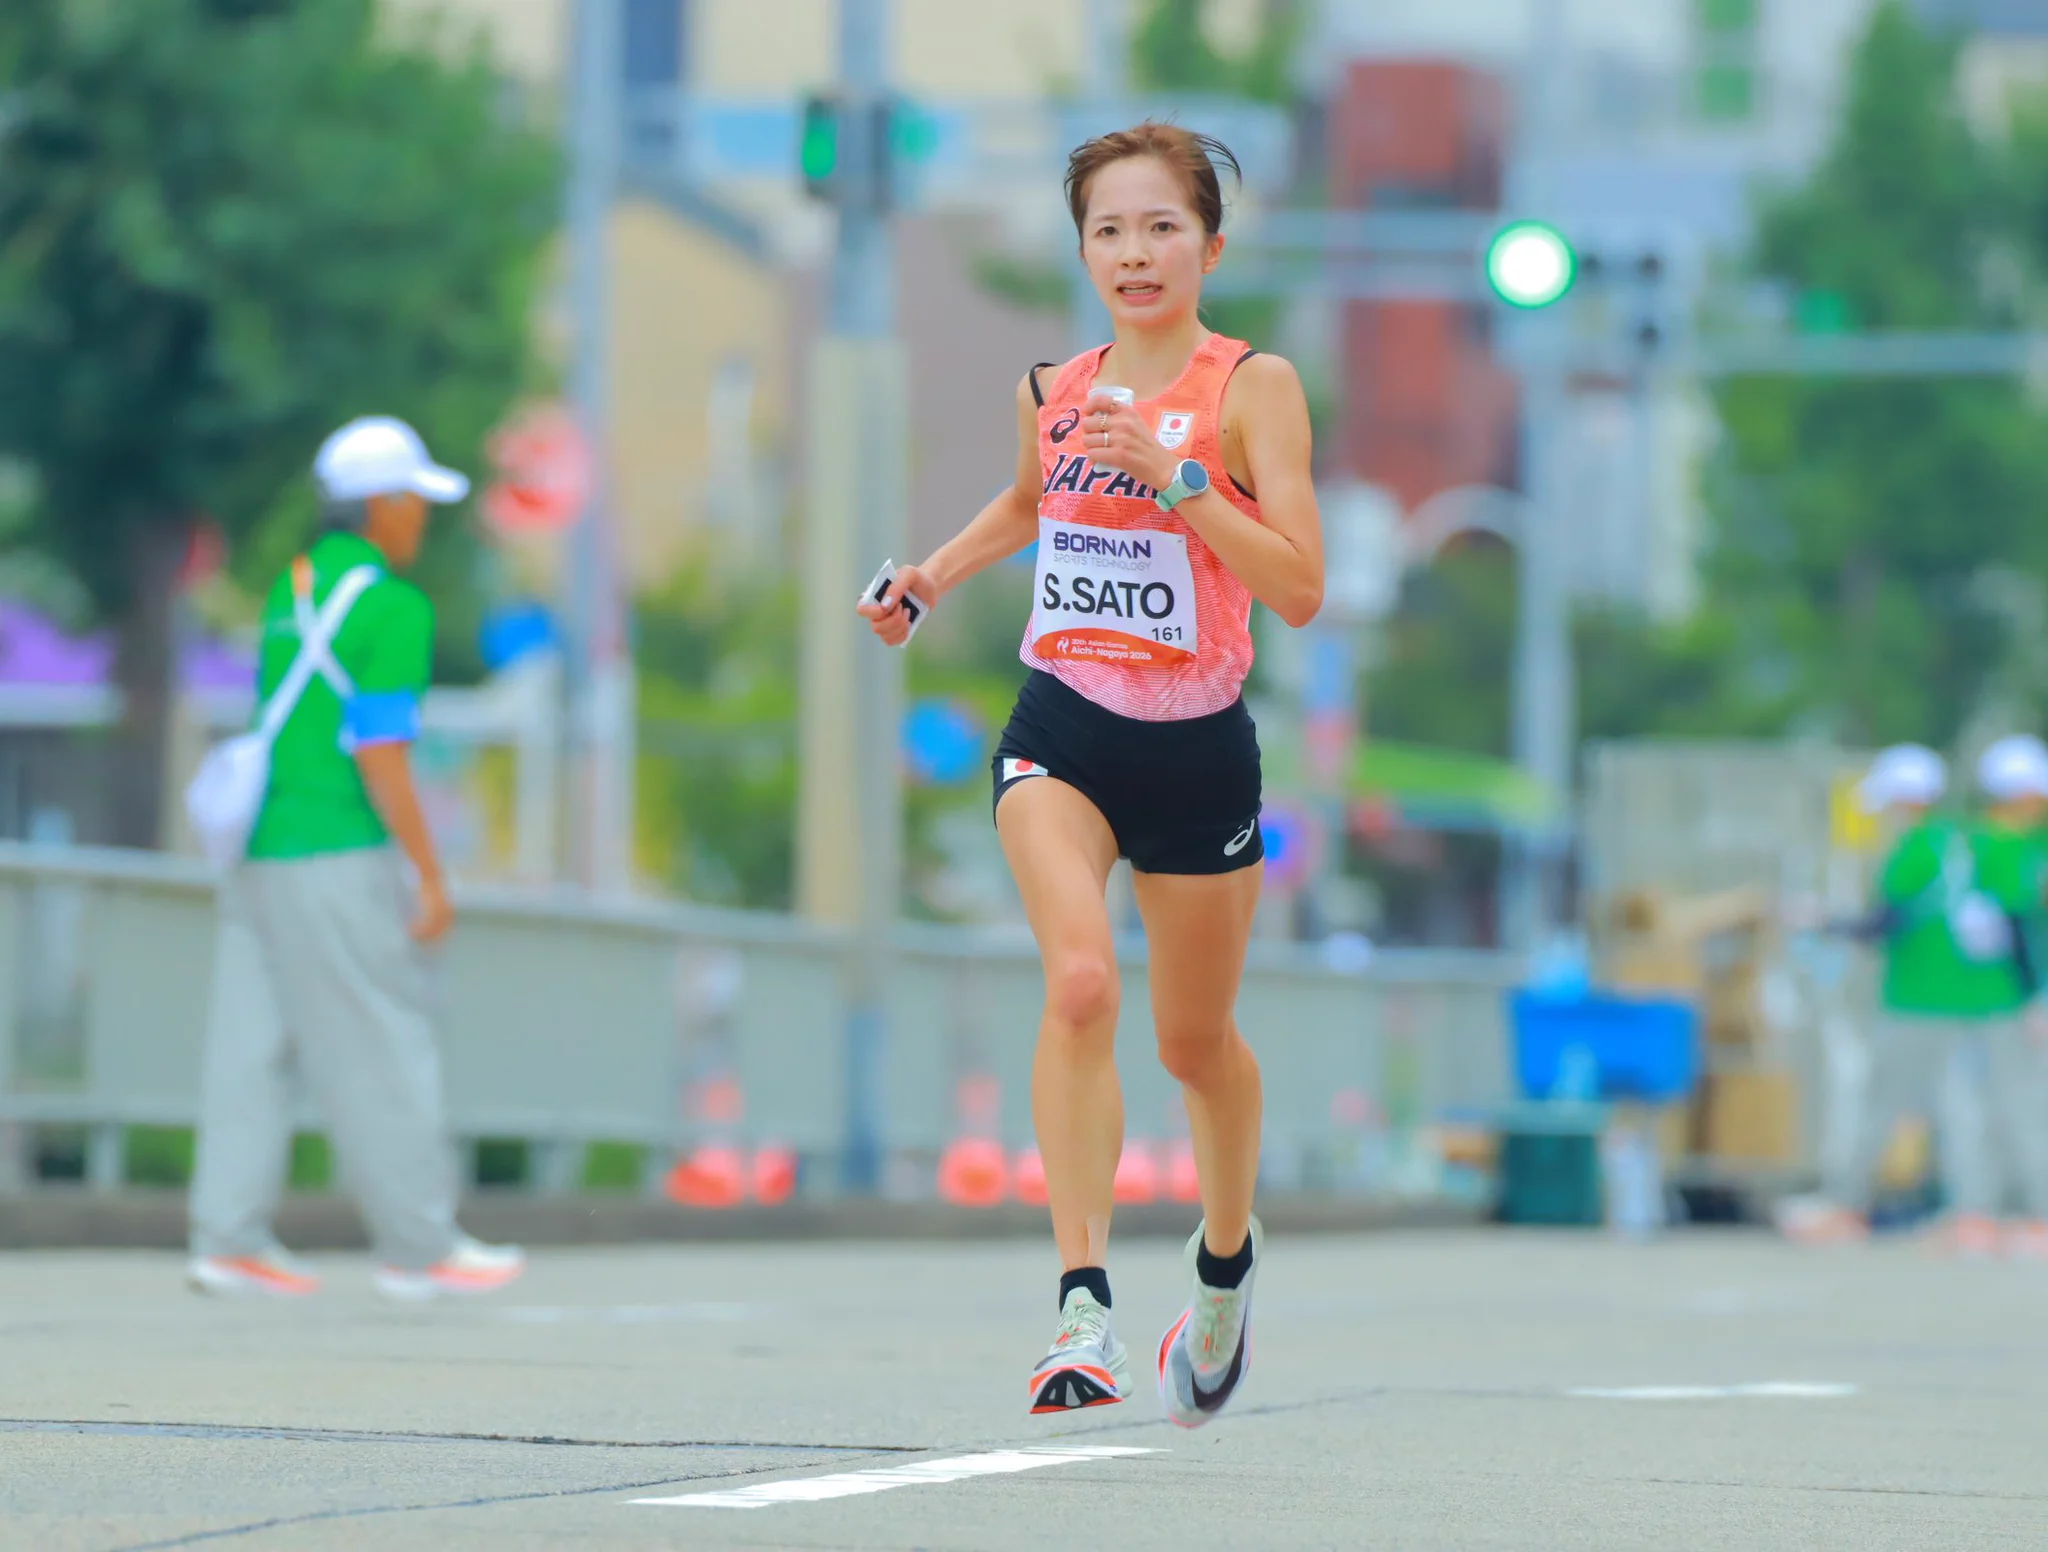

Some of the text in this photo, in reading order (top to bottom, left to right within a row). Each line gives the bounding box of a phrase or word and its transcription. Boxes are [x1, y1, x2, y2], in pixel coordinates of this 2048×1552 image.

[1053, 531, 1152, 559] BORNAN
[1053, 553, 1152, 571] SPORTS TECHNOLOGY
[1043, 572, 1175, 620] S.SATO
[1151, 626, 1183, 641] 161
[1071, 638, 1087, 646] 20th
[1088, 639, 1106, 647] Asian
[1071, 646, 1152, 660] Aichi-Nagoya 2026
